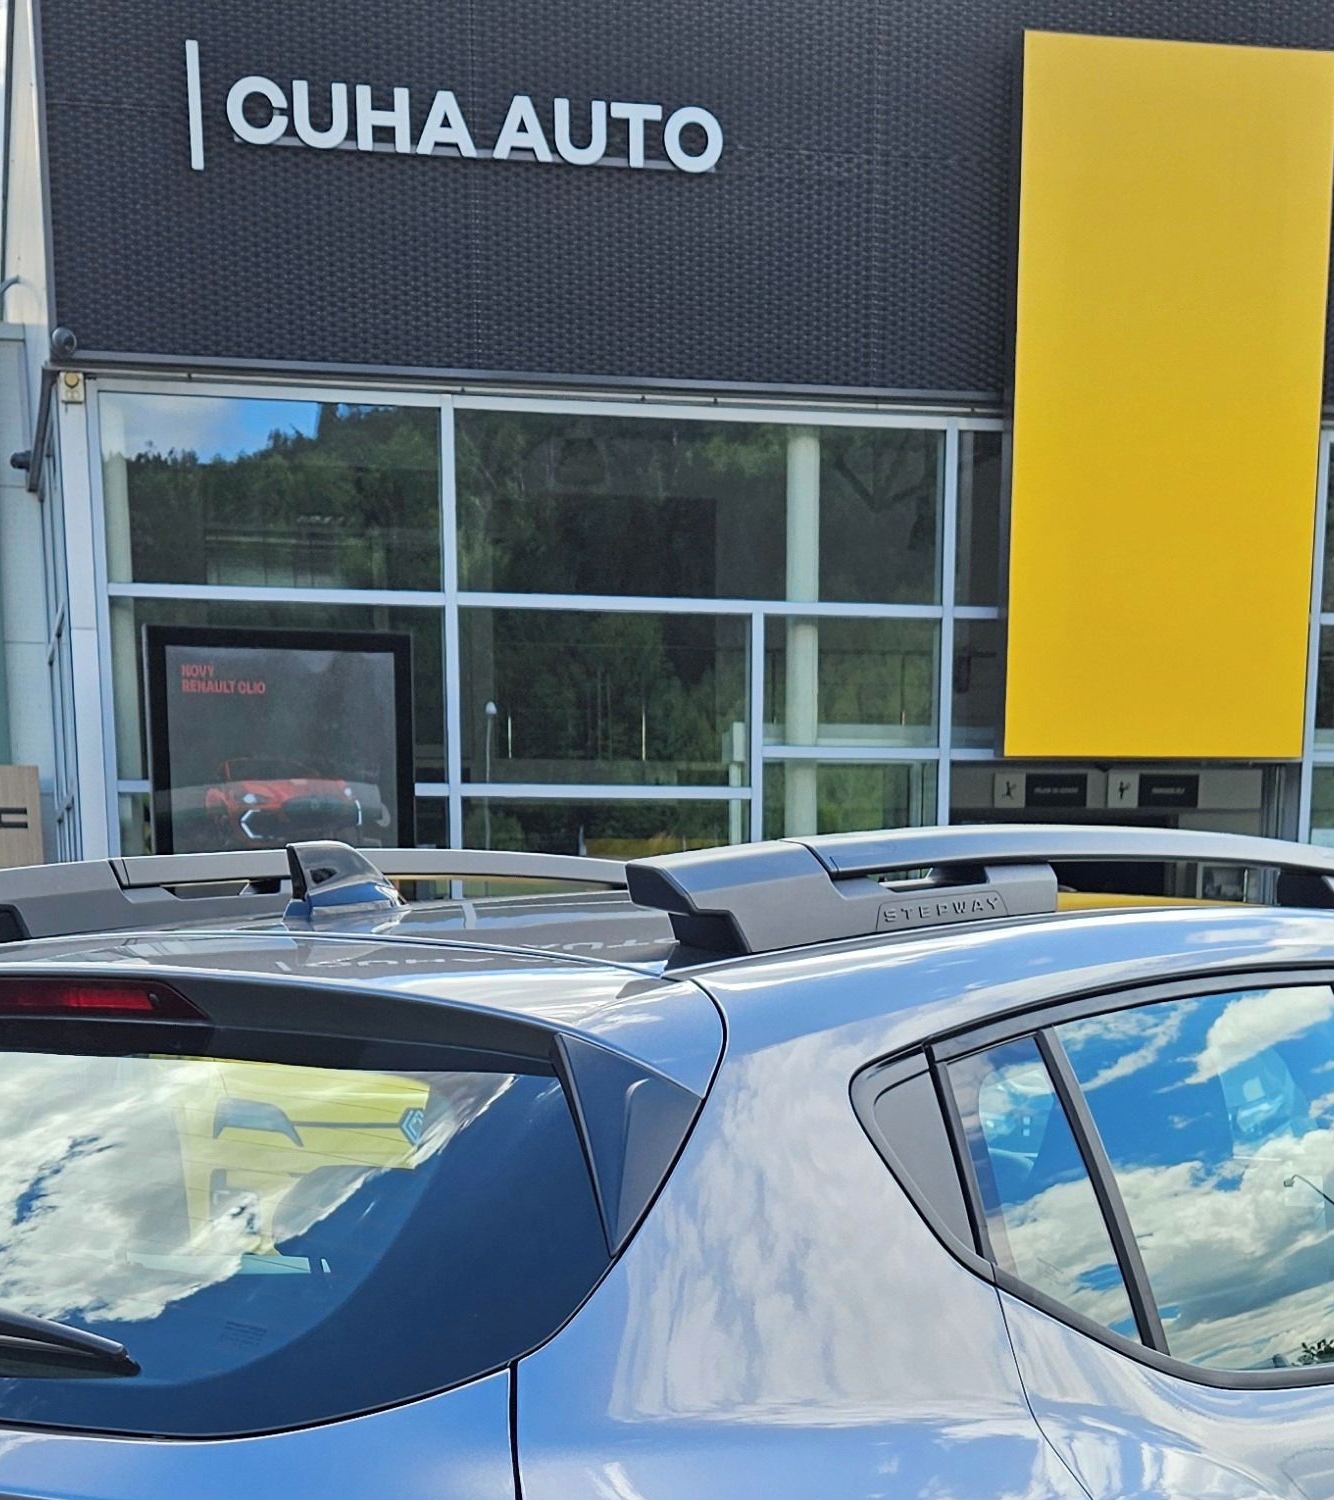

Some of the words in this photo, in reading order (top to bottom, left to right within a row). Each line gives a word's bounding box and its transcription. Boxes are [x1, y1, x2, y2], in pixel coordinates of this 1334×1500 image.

[225, 75, 477, 159] CUHA
[493, 95, 724, 174] AUTO
[181, 679, 236, 694] RENAULT
[237, 680, 267, 694] CLIO
[883, 897, 998, 922] STEPWAY
